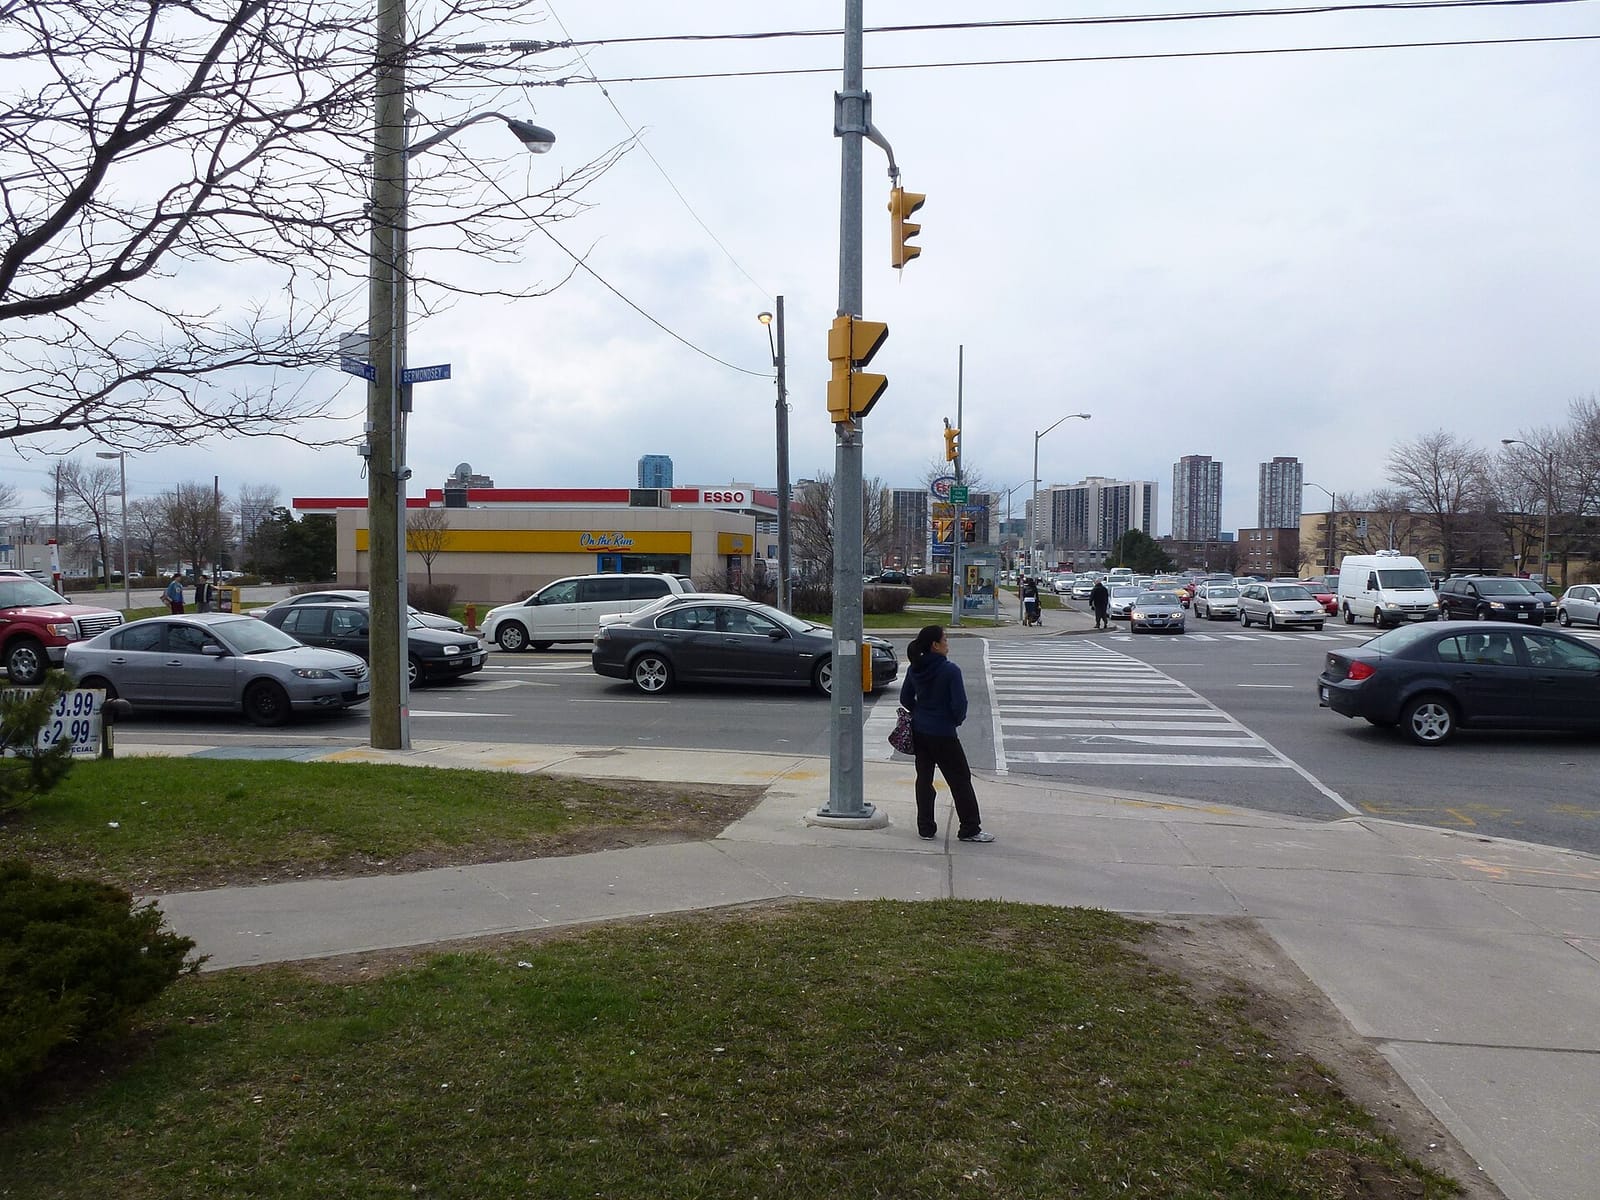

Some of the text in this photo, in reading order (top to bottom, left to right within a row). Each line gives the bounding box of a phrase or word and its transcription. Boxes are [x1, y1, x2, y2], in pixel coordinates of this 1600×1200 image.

[403, 367, 441, 382] BERMONDSEY
[704, 492, 744, 503] ESSO
[580, 532, 634, 547] On the Run
